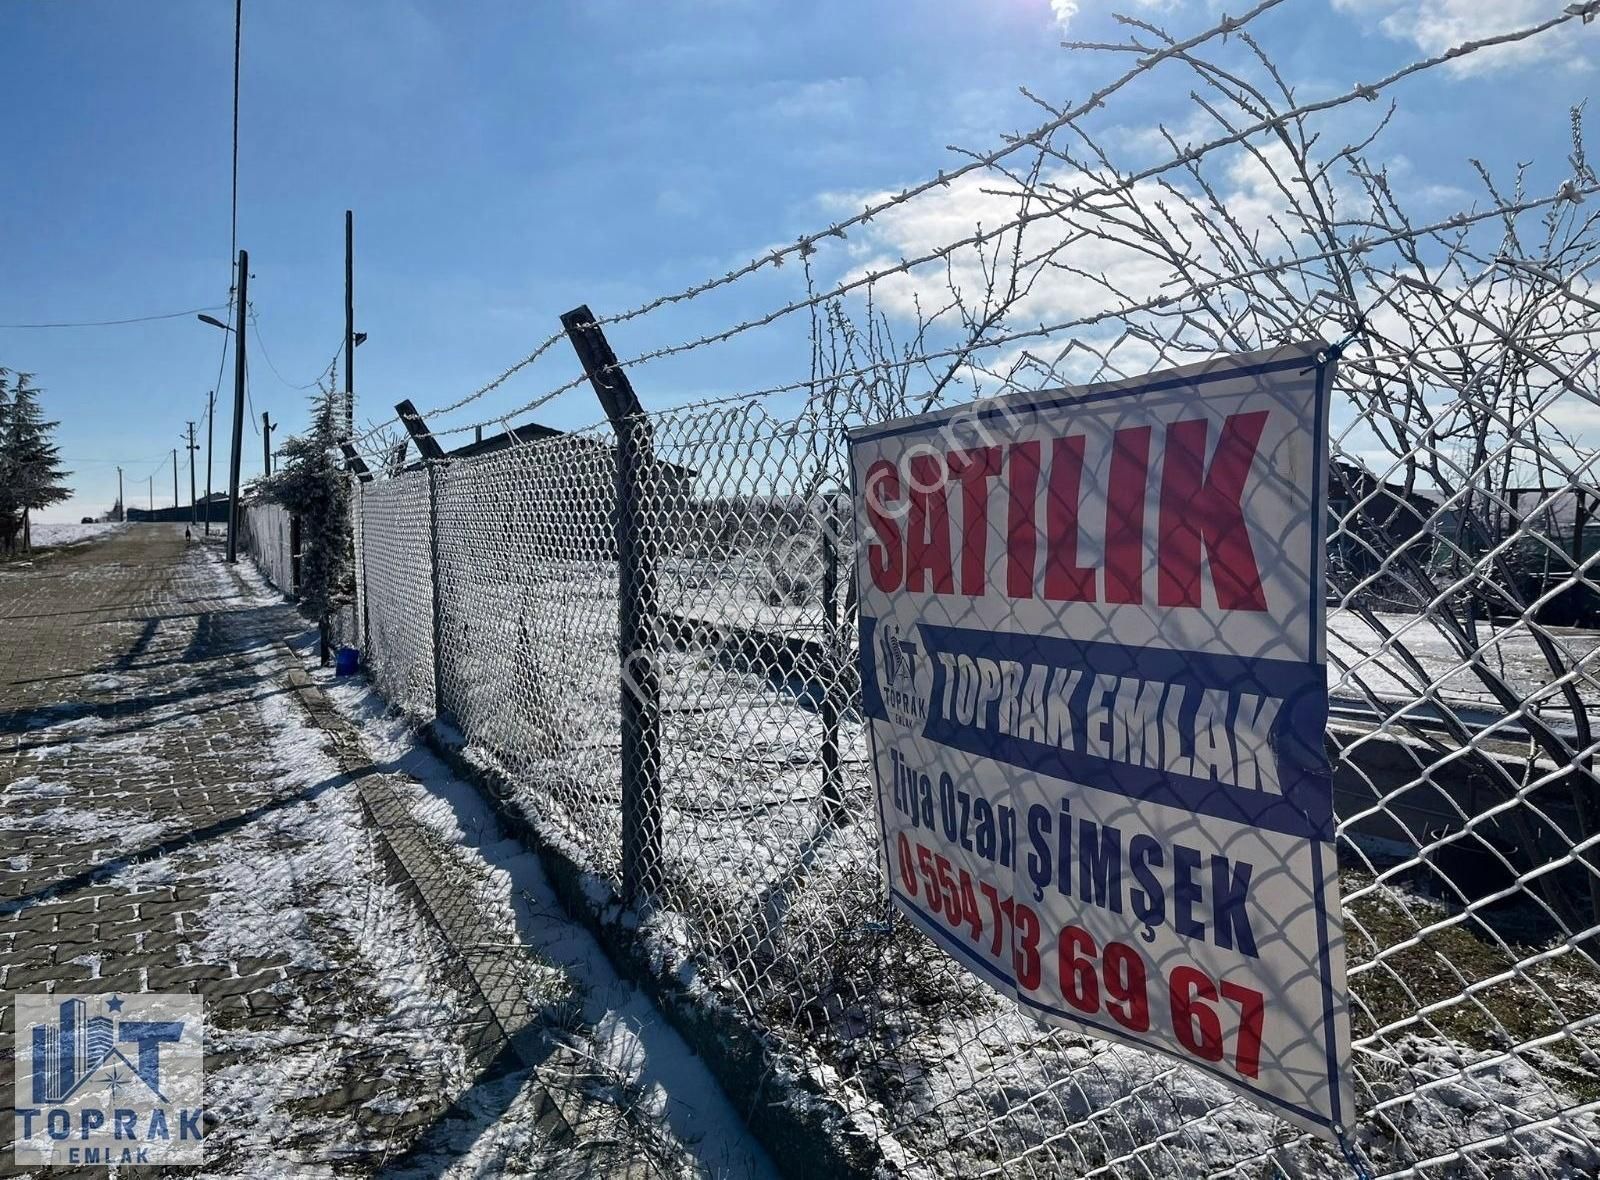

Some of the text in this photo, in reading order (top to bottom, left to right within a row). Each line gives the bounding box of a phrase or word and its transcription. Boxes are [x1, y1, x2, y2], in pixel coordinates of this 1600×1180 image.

[865, 410, 1270, 612] SATILIK
[884, 687, 926, 719] TOPRAK
[939, 652, 1284, 796] TOPRAK EMLAK
[940, 771, 1017, 873] Ozan
[1027, 798, 1260, 959] ŞİMŞEK
[1058, 925, 1150, 1033] 69
[1169, 965, 1265, 1081] 67
